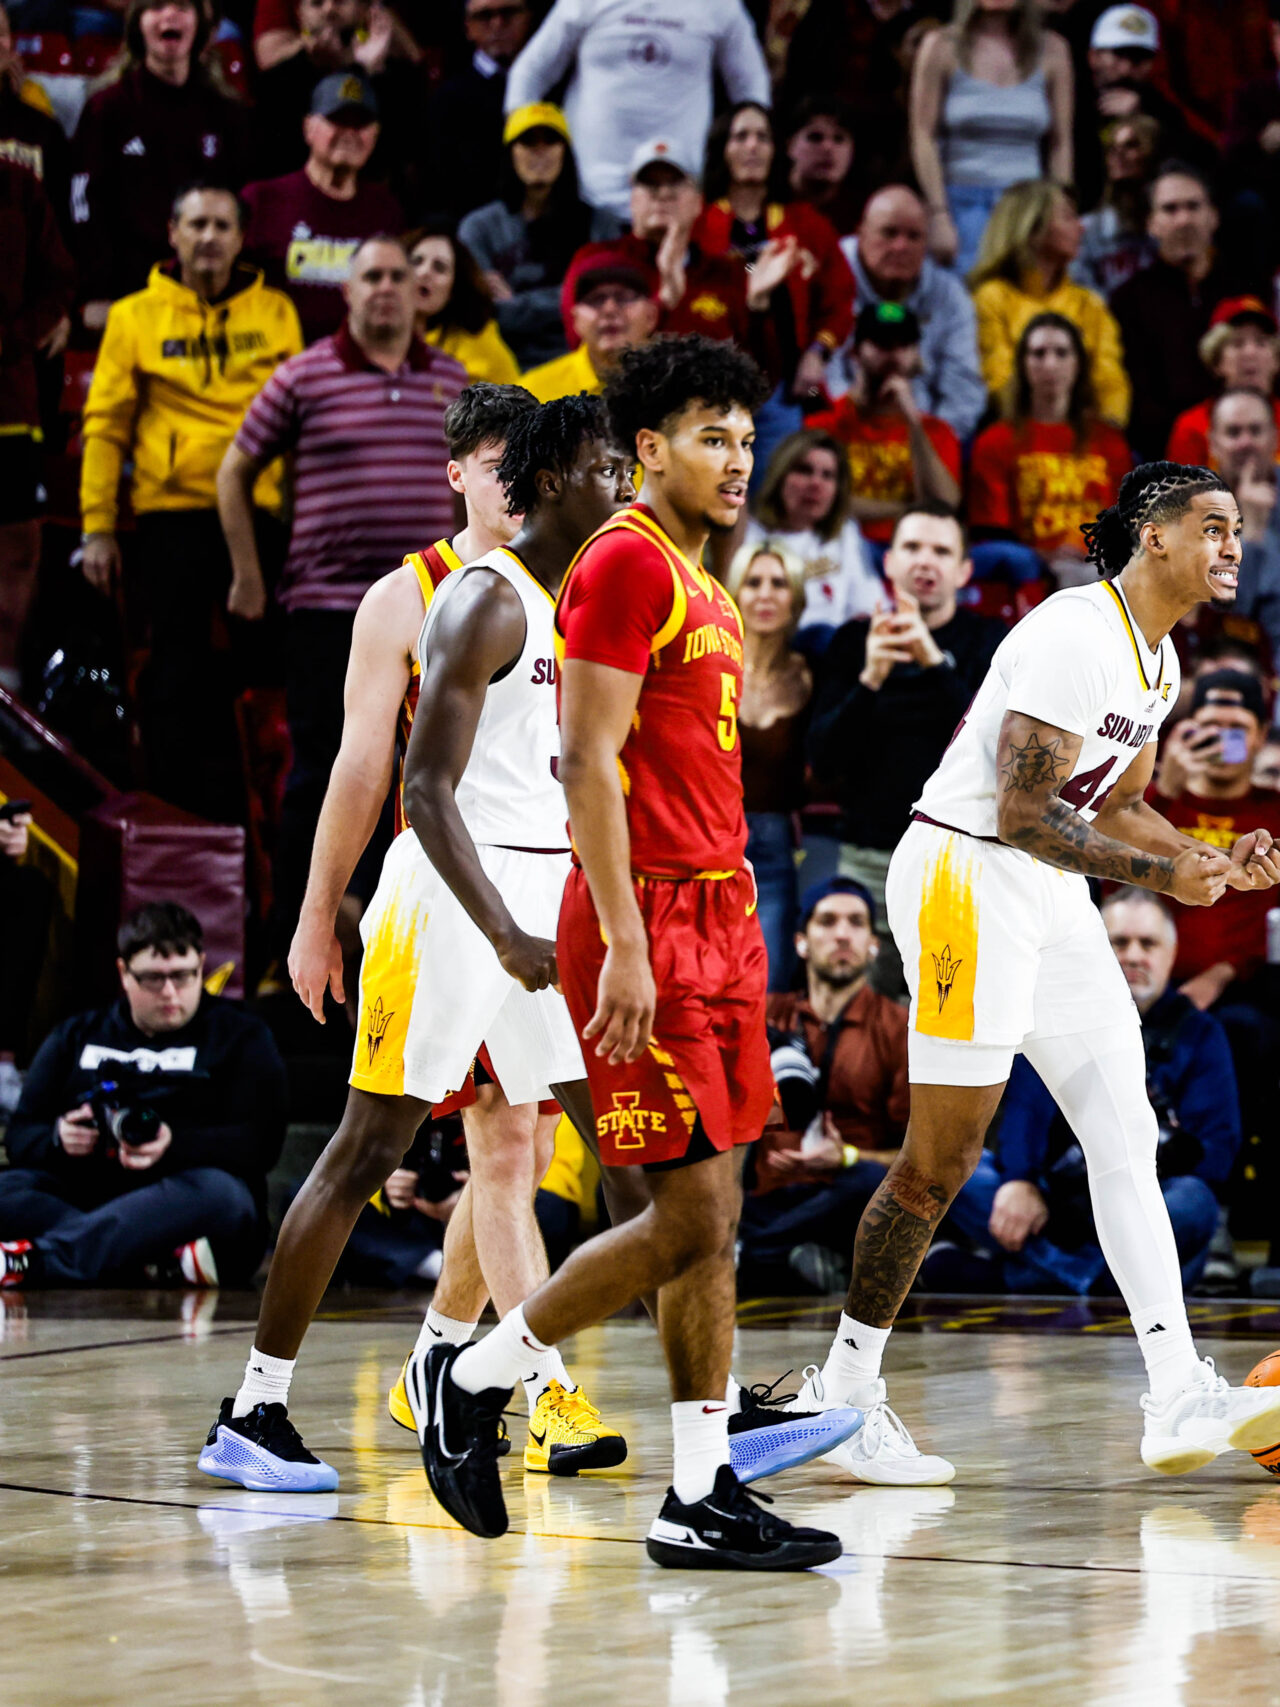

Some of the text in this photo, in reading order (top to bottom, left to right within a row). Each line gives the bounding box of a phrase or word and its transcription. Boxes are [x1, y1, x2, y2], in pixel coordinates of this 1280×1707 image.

[682, 623, 723, 664] IOWA
[530, 657, 556, 685] SU
[717, 672, 737, 752] 5
[1096, 712, 1134, 744] SUN
[597, 1109, 667, 1137] STATE
